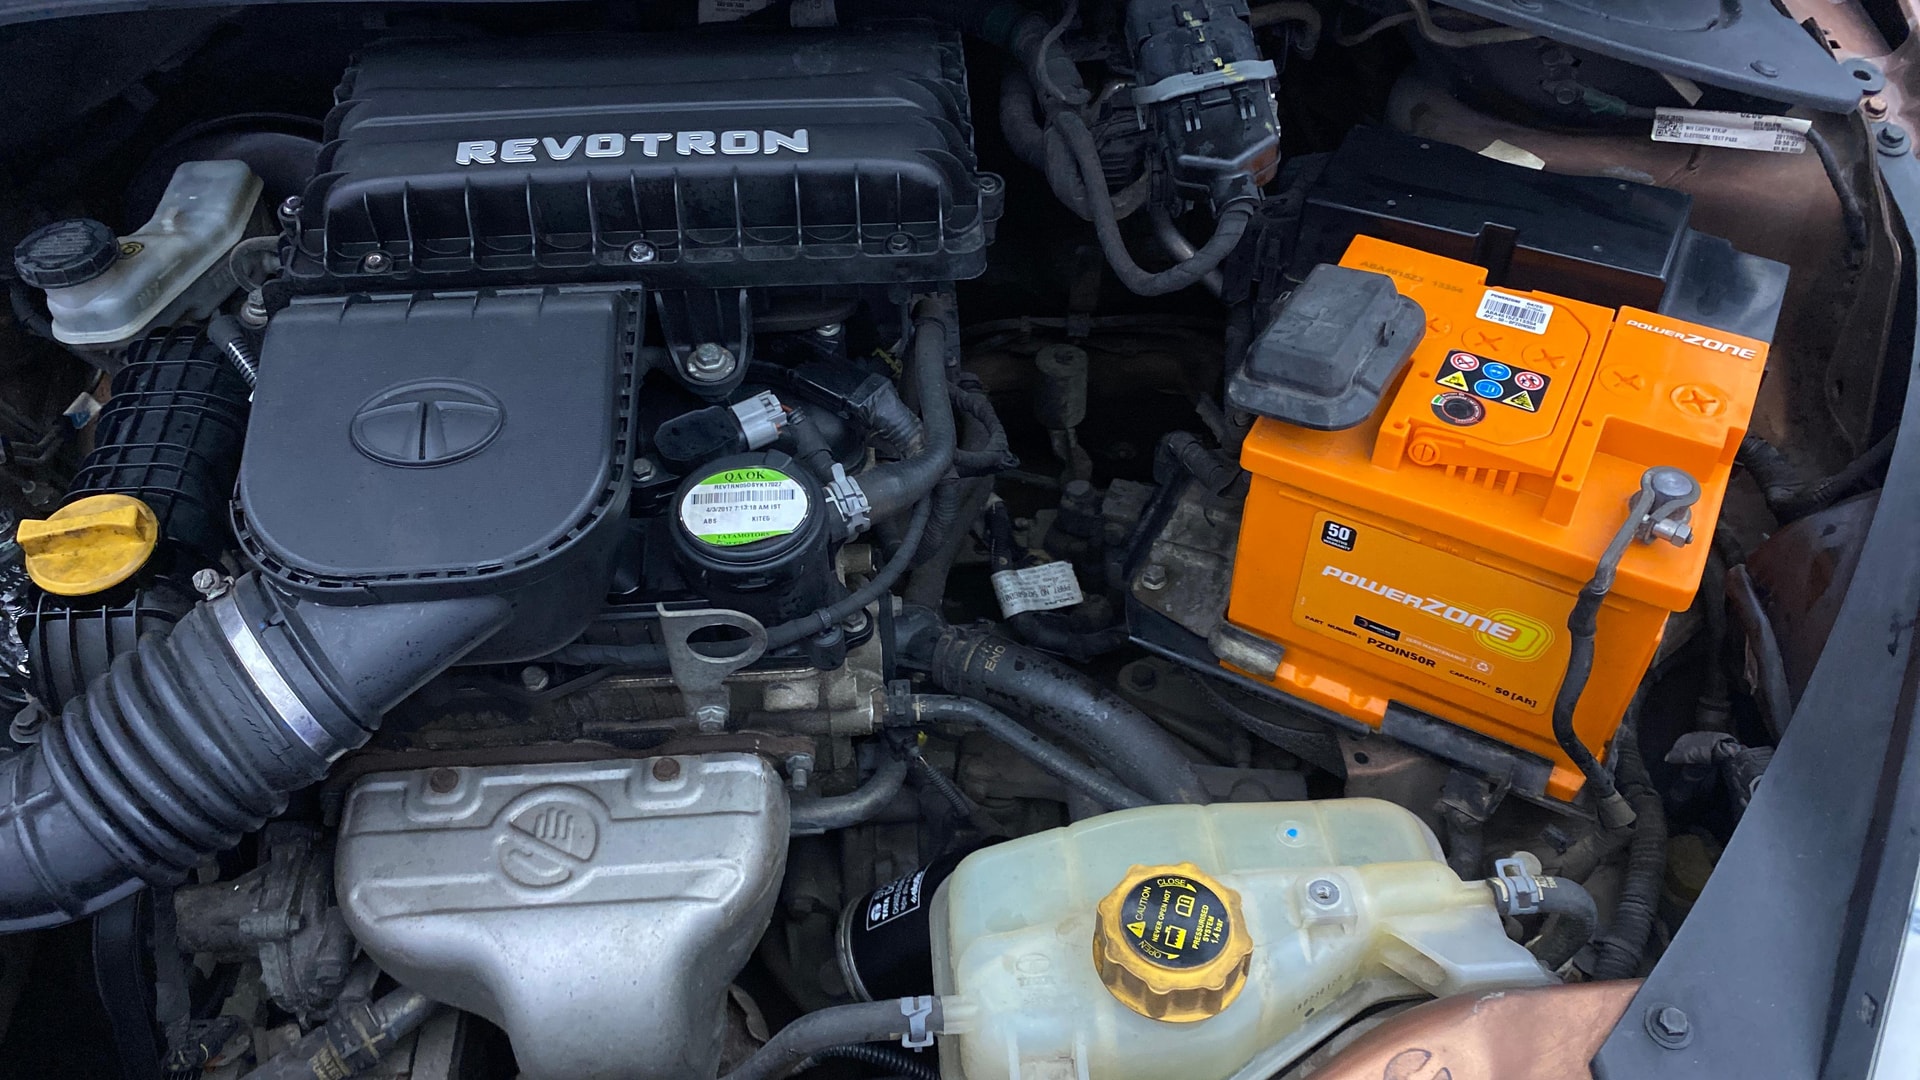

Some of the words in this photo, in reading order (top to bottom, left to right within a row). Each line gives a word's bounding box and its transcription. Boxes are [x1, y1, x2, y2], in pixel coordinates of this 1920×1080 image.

[455, 129, 809, 166] REVOTRON
[1626, 319, 1757, 360] POWERZONE
[725, 472, 743, 482] QA
[746, 470, 765, 480] OK
[1327, 523, 1350, 541] 50
[1322, 565, 1516, 641] POWERZONE
[1304, 615, 1324, 625] PART
[1367, 637, 1436, 668] PZDIN50R
[1405, 635, 1422, 646] ZERO
[985, 646, 1006, 672] END
[1494, 686, 1510, 697] 50
[1511, 692, 1537, 708] [Ah]
[1157, 878, 1187, 886] CLOSE
[882, 896, 890, 920] TATA
[1135, 886, 1152, 921] CAUTION
[1152, 920, 1163, 942] NEVER
[1158, 903, 1167, 920] OPEN
[1163, 889, 1171, 903] HOT
[1192, 904, 1209, 949] PRESSURISED
[1202, 915, 1214, 942] SYSTEM
[1139, 940, 1162, 959] OPEN
